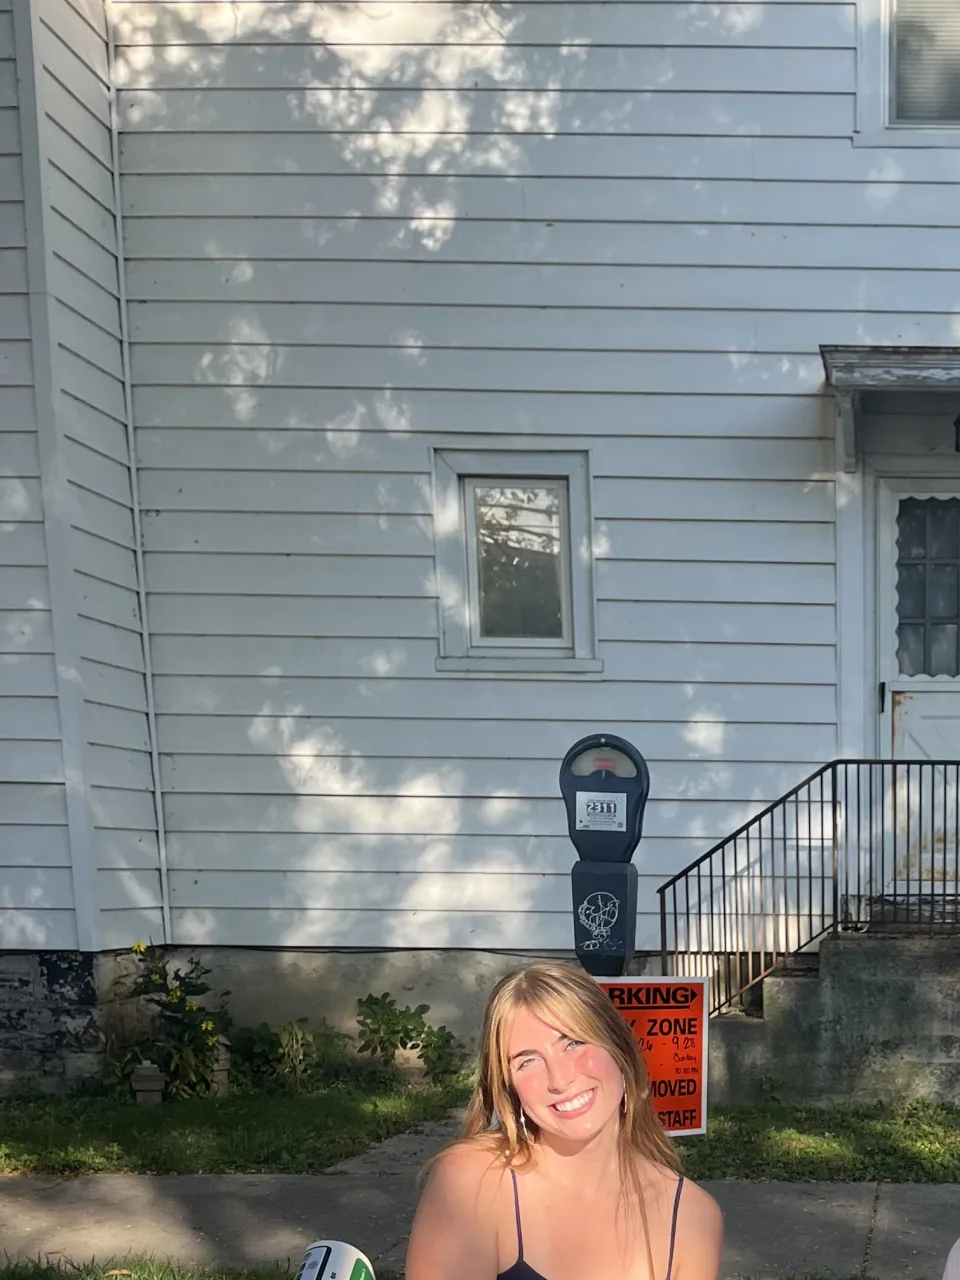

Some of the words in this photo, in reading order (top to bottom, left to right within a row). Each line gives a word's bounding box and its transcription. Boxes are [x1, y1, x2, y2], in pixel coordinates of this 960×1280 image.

[587, 802, 615, 813] 2311
[608, 986, 690, 1005] RKING
[647, 1017, 697, 1036] ZONE
[650, 1078, 697, 1098] MOVED
